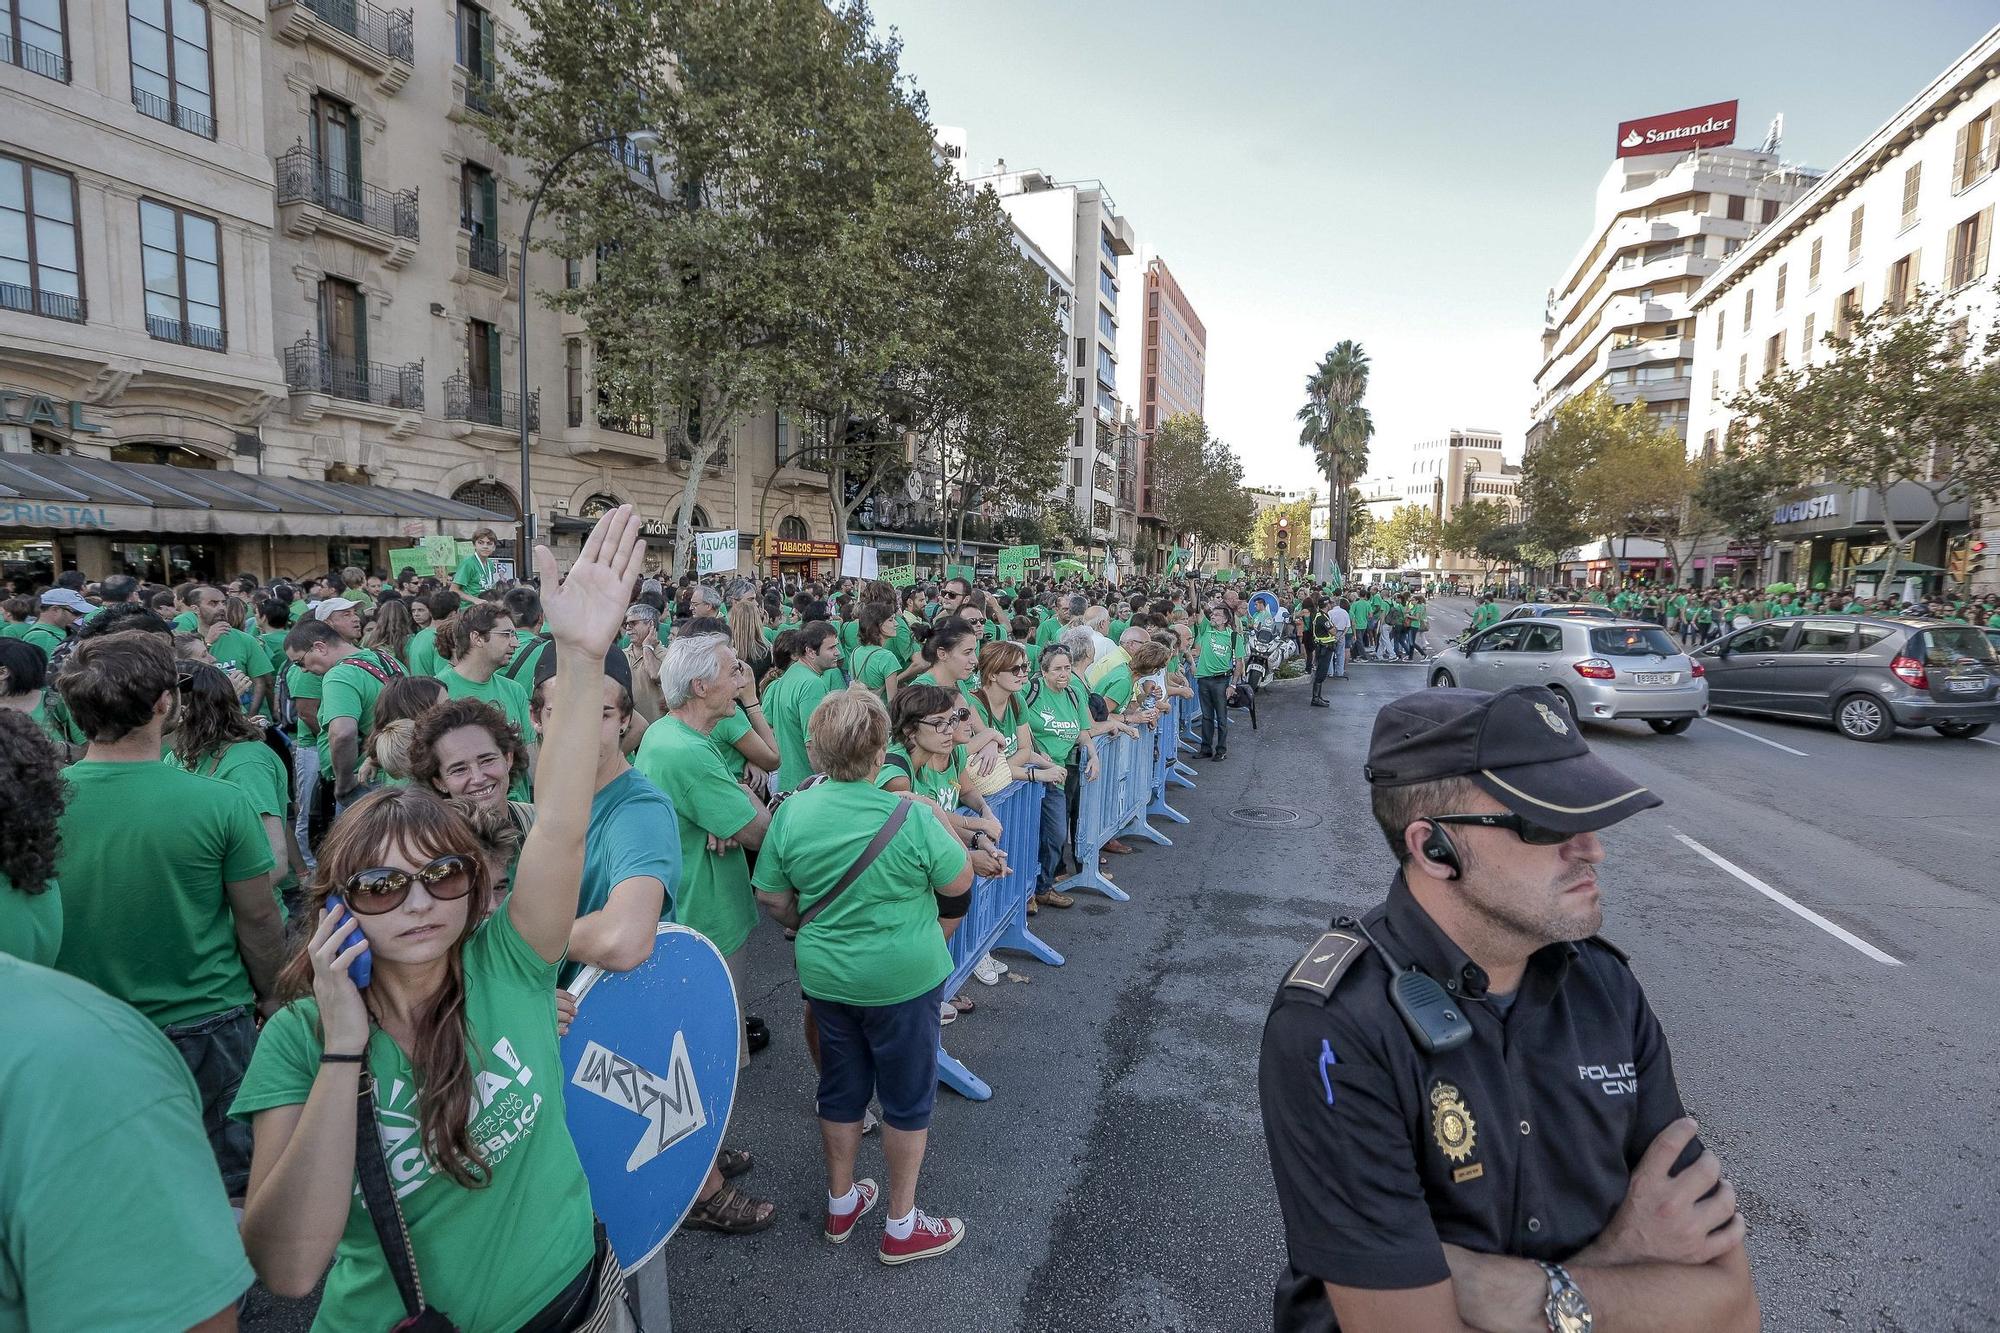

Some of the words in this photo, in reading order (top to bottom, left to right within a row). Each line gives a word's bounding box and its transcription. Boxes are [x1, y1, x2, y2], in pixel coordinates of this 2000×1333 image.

[1645, 117, 1732, 144] Santander
[1771, 494, 1838, 524] AUGUSTA
[646, 521, 669, 535] MÓN
[779, 541, 812, 553] TABACOS
[1051, 719, 1080, 732] CRIDA!
[469, 1115, 495, 1138] PER
[492, 1092, 519, 1117] UNA
